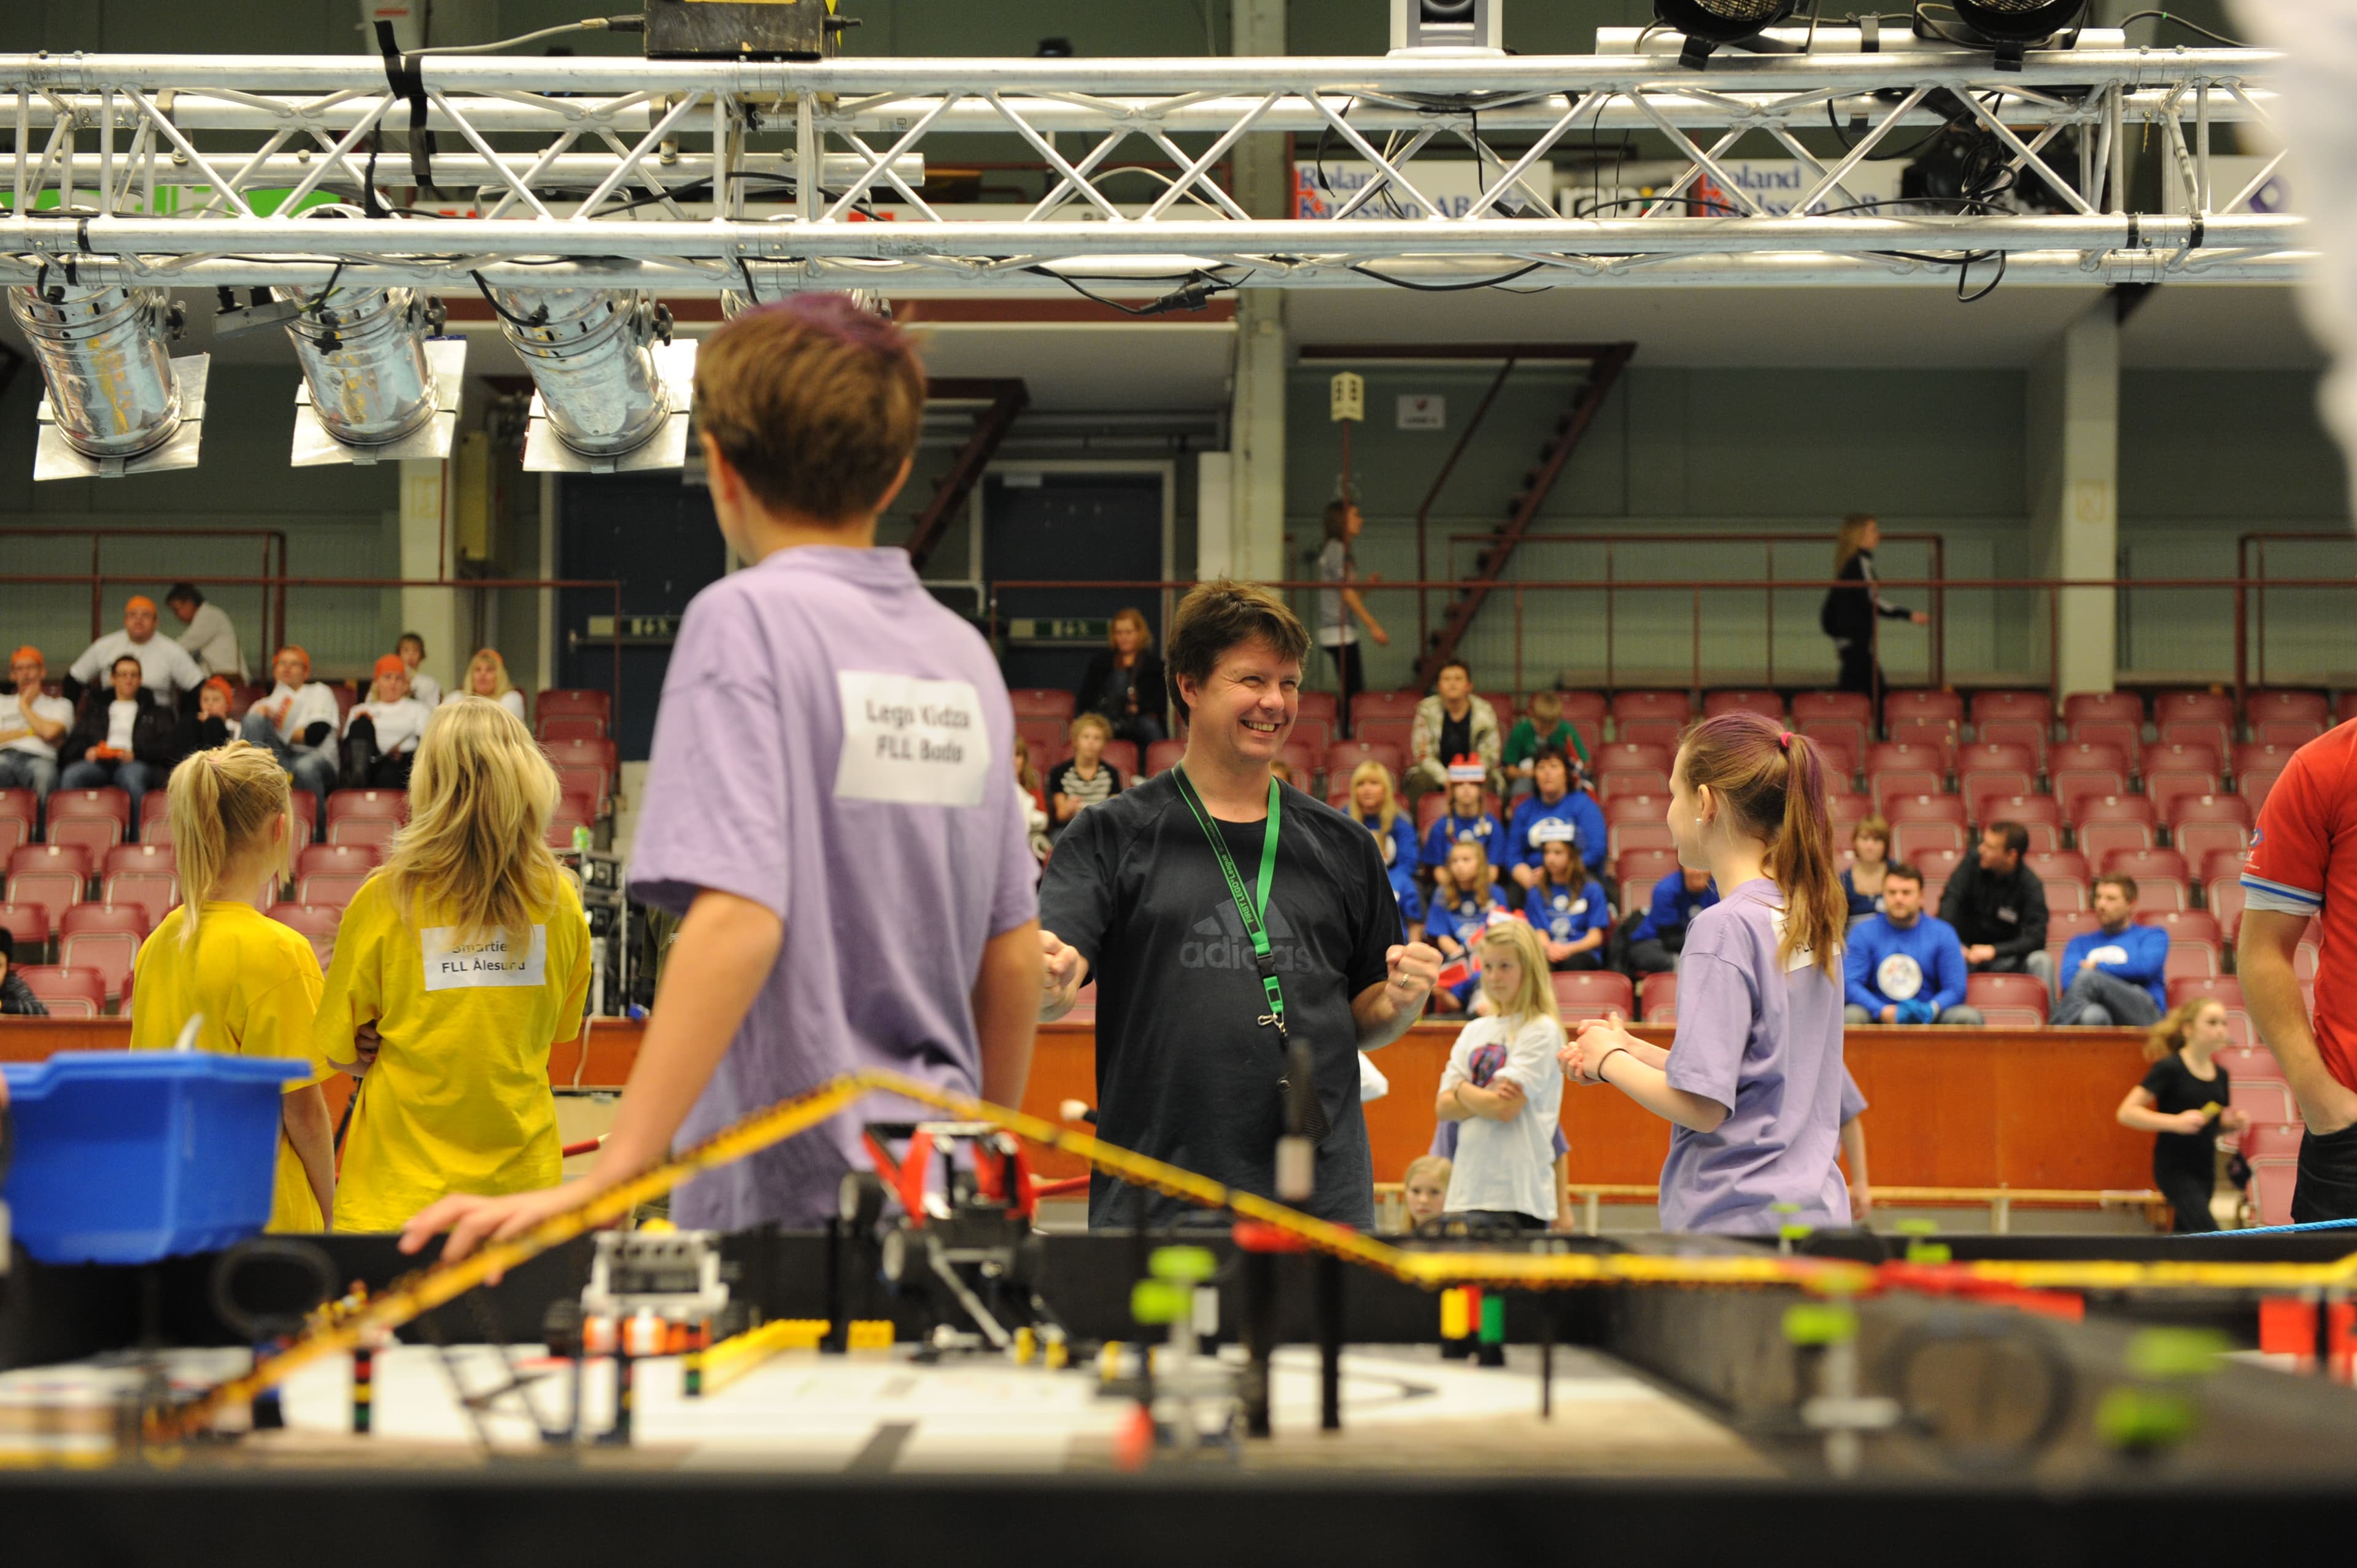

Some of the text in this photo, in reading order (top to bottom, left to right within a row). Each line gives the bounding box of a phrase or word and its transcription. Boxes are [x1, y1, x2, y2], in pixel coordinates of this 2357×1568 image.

[1300, 164, 1393, 190] Rolan
[1706, 164, 1801, 188] oland
[875, 735, 914, 760] FLL
[1239, 902, 1254, 924] FIRST
[442, 960, 468, 973] FLL
